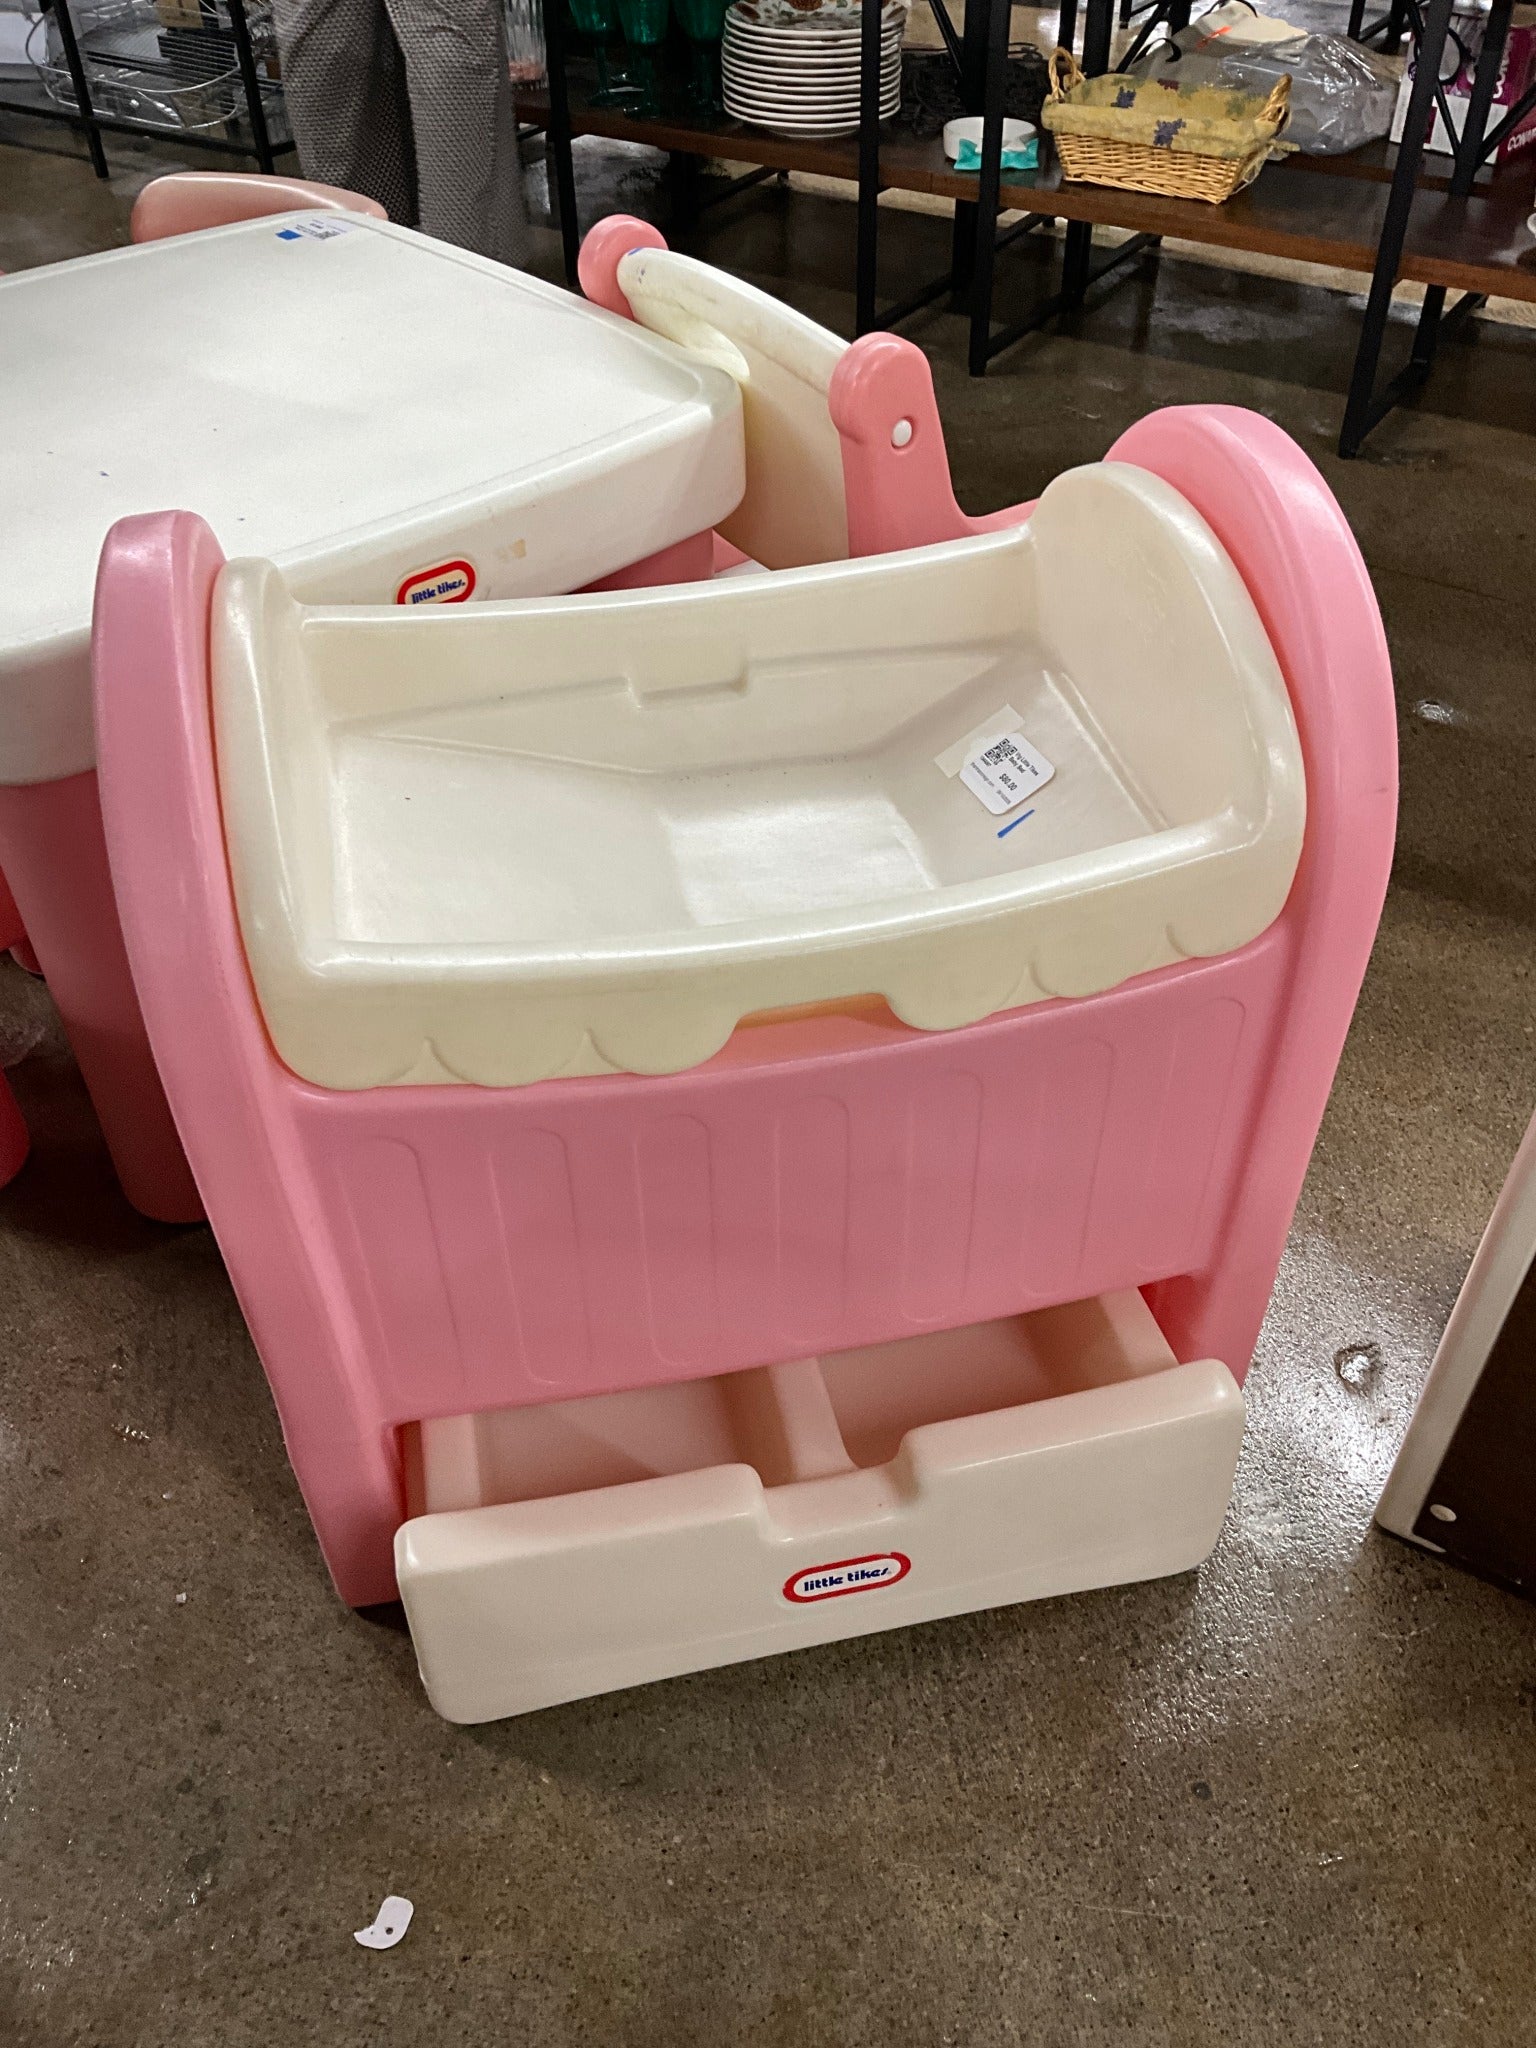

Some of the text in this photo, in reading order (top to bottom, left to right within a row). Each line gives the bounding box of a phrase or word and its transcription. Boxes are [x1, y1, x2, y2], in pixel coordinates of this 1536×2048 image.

[411, 588, 437, 604] little
[804, 1567, 889, 1591] little tikes
